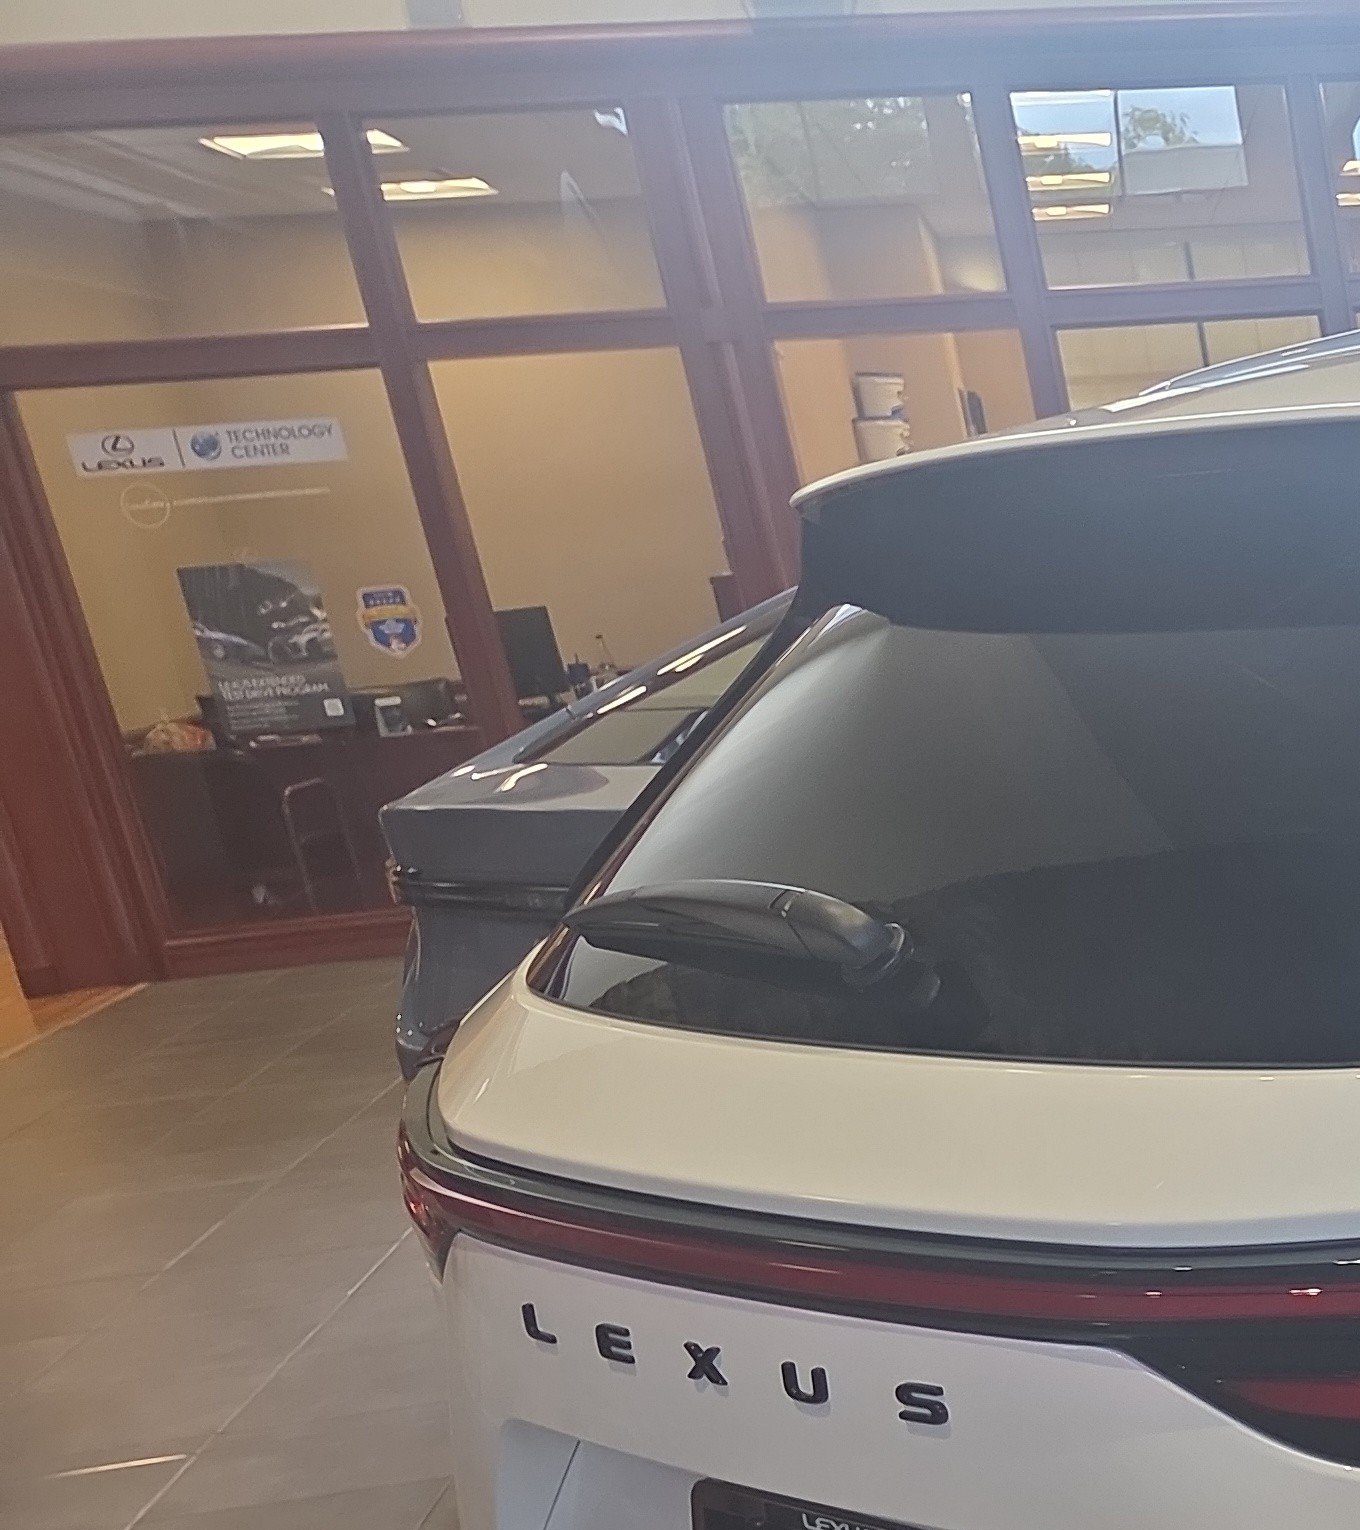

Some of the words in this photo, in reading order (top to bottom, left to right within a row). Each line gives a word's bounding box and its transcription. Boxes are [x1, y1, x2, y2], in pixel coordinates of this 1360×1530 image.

[225, 422, 333, 444] TECHNOLOGY
[230, 441, 291, 460] CENTER
[81, 455, 165, 473] LEXUS
[521, 1302, 950, 1426] LEXUS
